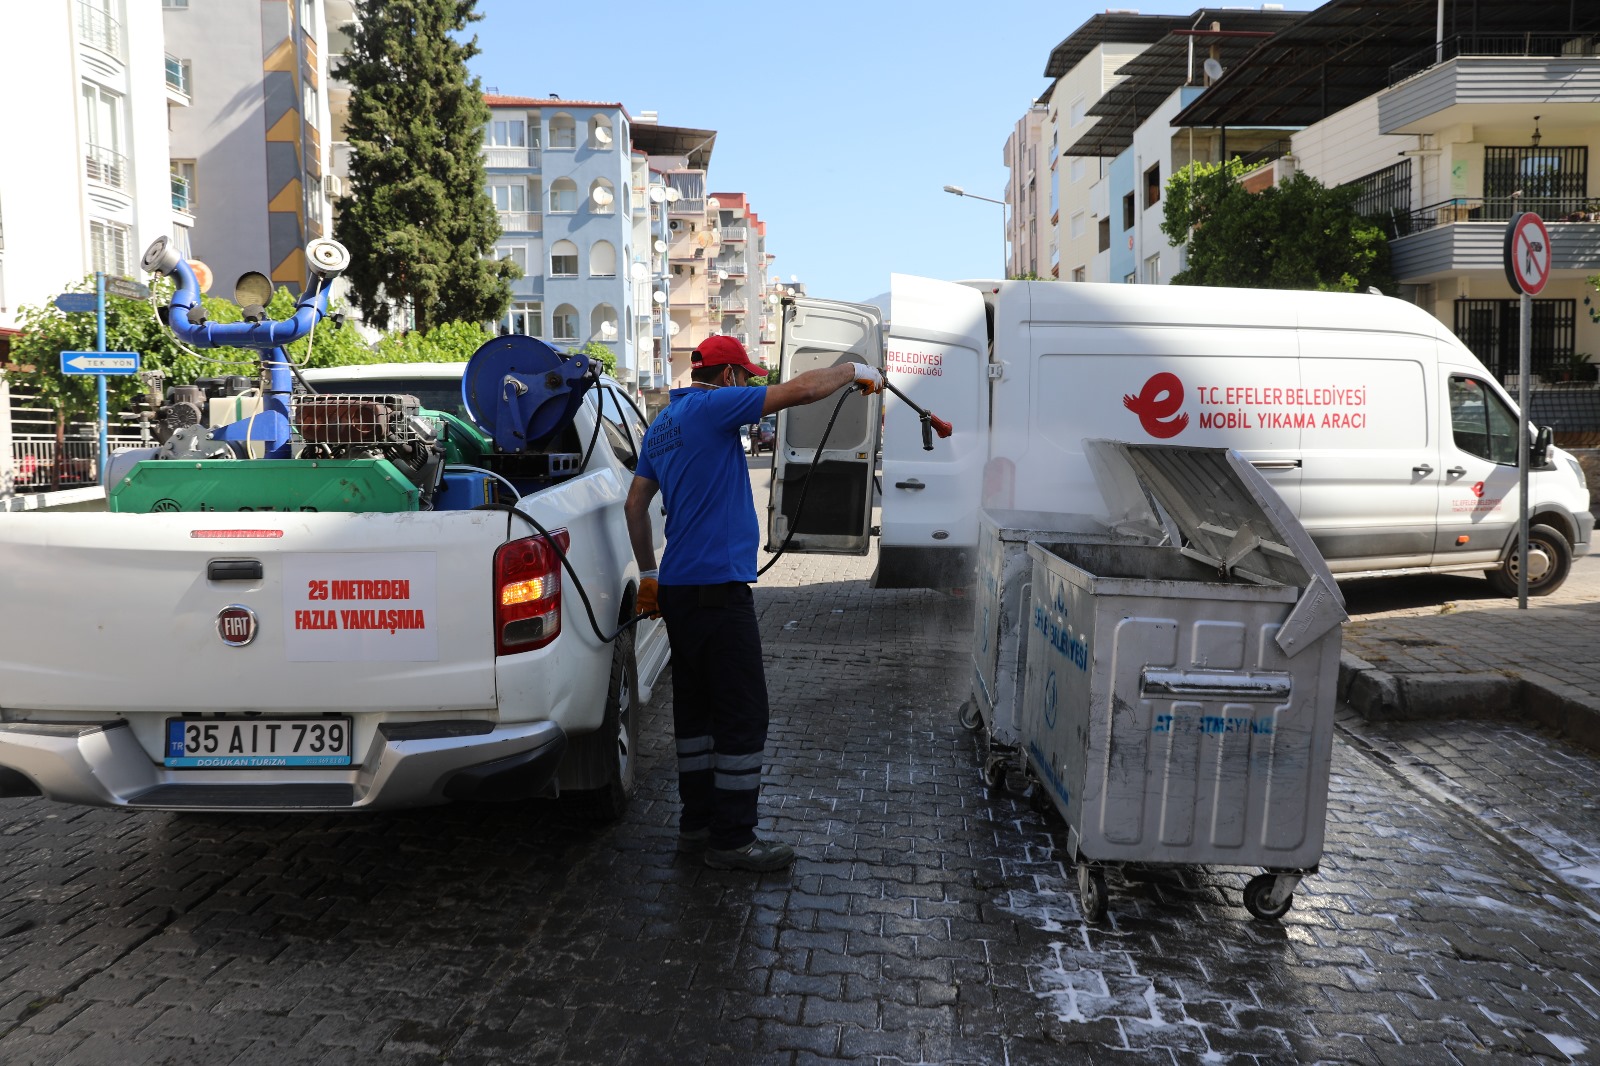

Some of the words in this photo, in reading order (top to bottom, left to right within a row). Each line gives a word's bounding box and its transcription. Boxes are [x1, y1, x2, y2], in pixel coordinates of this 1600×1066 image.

[888, 350, 943, 366] BELEDİYESİ
[896, 364, 943, 376] MÜDÜRLÜĞÜ
[1197, 386, 1223, 405] T.C.
[1226, 387, 1283, 405] EFELER
[1286, 385, 1366, 406] BELEDİYESİ
[1200, 408, 1252, 428] MOBİL
[1257, 413, 1316, 428] YIKAMA
[1321, 413, 1366, 428] ARACI
[308, 580, 328, 600] 25
[332, 580, 410, 600] METREDEN
[224, 616, 249, 636] FIAT
[295, 610, 338, 630] FAZLA
[340, 610, 425, 635] YAKLAŞMA
[171, 742, 183, 751] TR
[185, 725, 219, 753] 35
[228, 725, 281, 753] AIT
[291, 724, 344, 753] 739
[197, 757, 249, 767] DOĞUKAN
